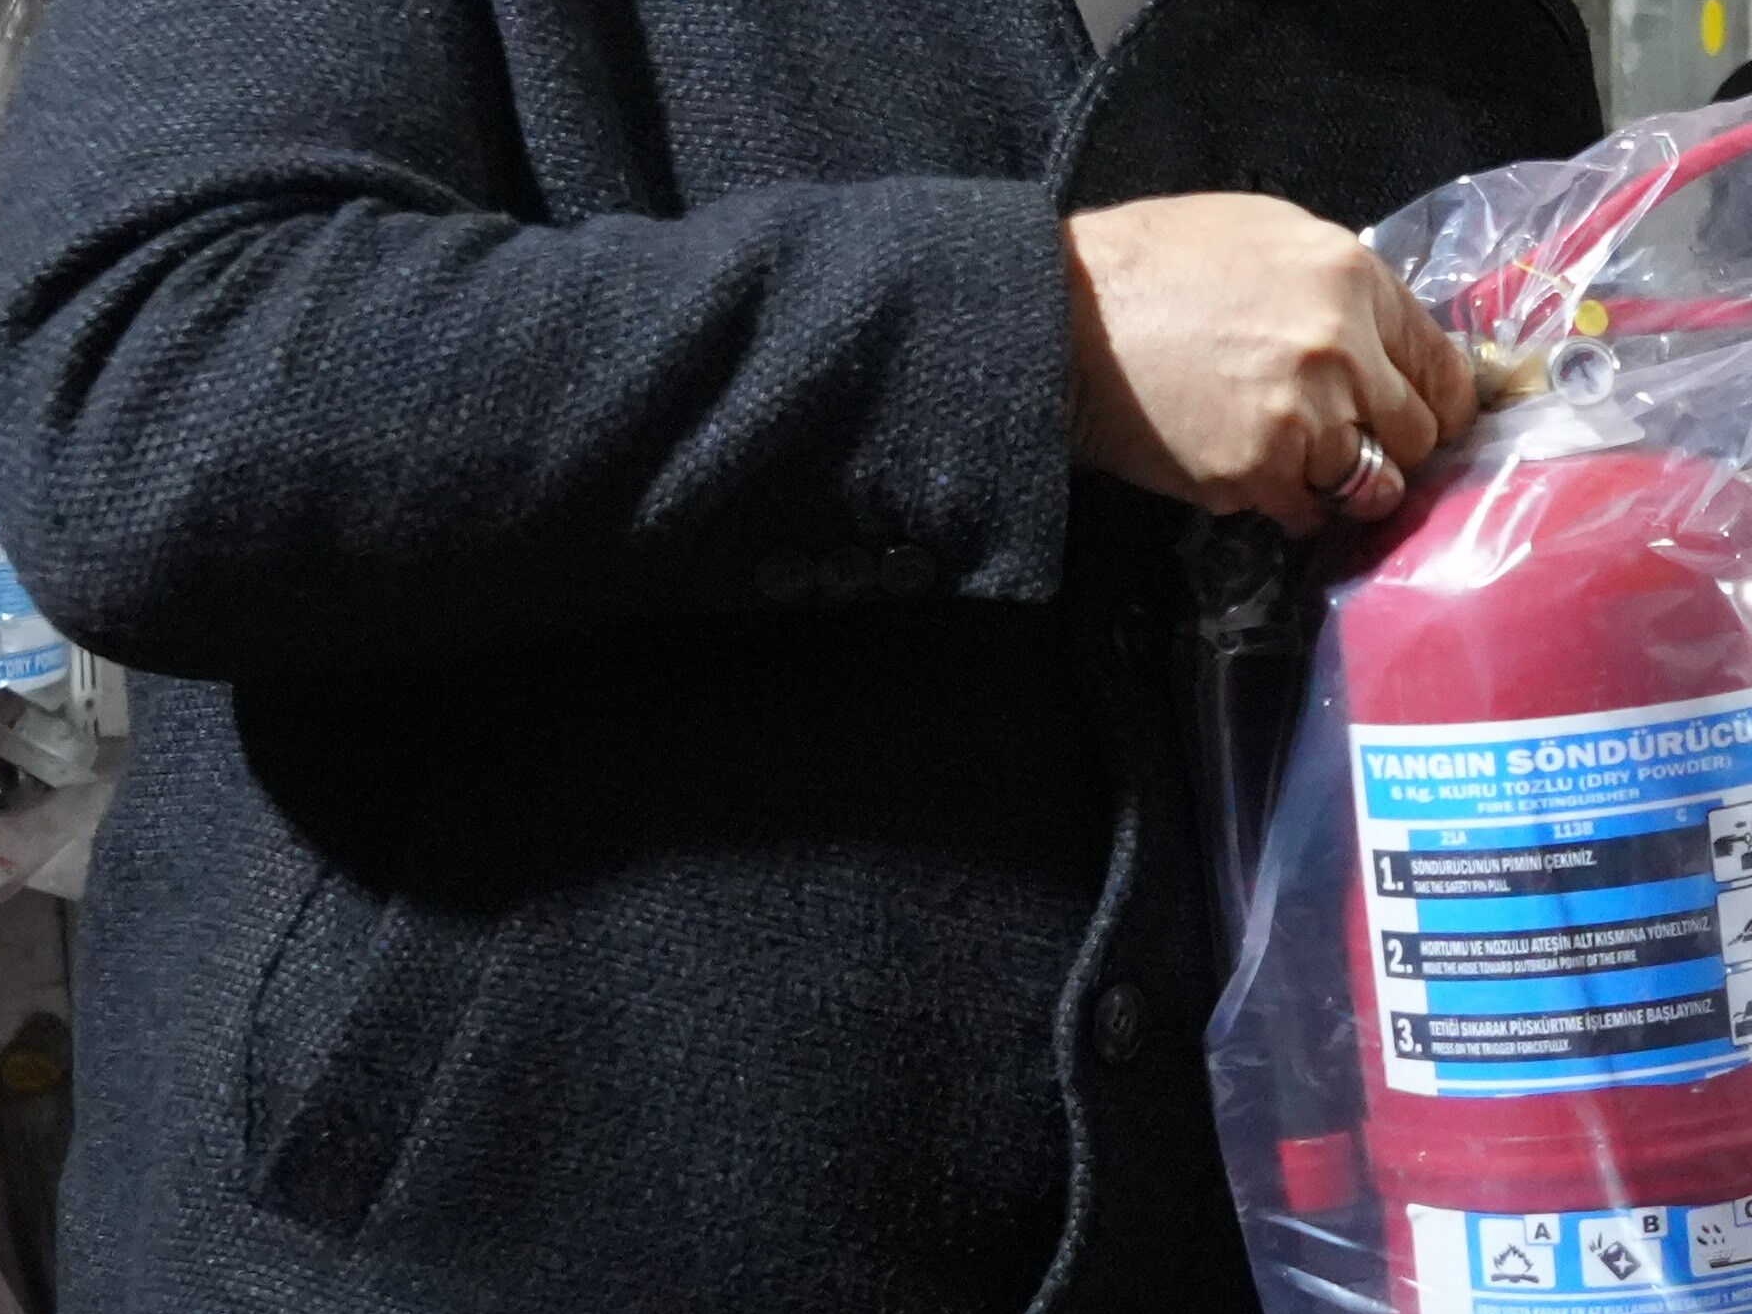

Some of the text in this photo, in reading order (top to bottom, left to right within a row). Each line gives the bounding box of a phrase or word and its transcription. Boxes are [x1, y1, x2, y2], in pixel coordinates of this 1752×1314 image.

[1367, 752, 1495, 780] YANGIN
[1440, 783, 1497, 800] KURU
[1504, 777, 1574, 797] TOZLU
[1579, 770, 1631, 793] (DRY
[1637, 756, 1732, 783] POWDER)
[1477, 800, 1515, 815] FIRE
[1379, 856, 1404, 891] 1.
[1501, 853, 1543, 873] PİMİNİ
[1388, 939, 1413, 974] 2.
[1420, 939, 1468, 957] HORTUMU
[1469, 939, 1483, 955] VE
[1485, 937, 1529, 955] NOZULU
[1573, 930, 1596, 948] ALT
[1398, 1018, 1422, 1053] 3.
[1461, 1019, 1509, 1037] SIKARAK
[1510, 1014, 1584, 1036] PÜSKÜRTME
[1533, 1223, 1552, 1241] A
[1644, 1214, 1660, 1235] B
